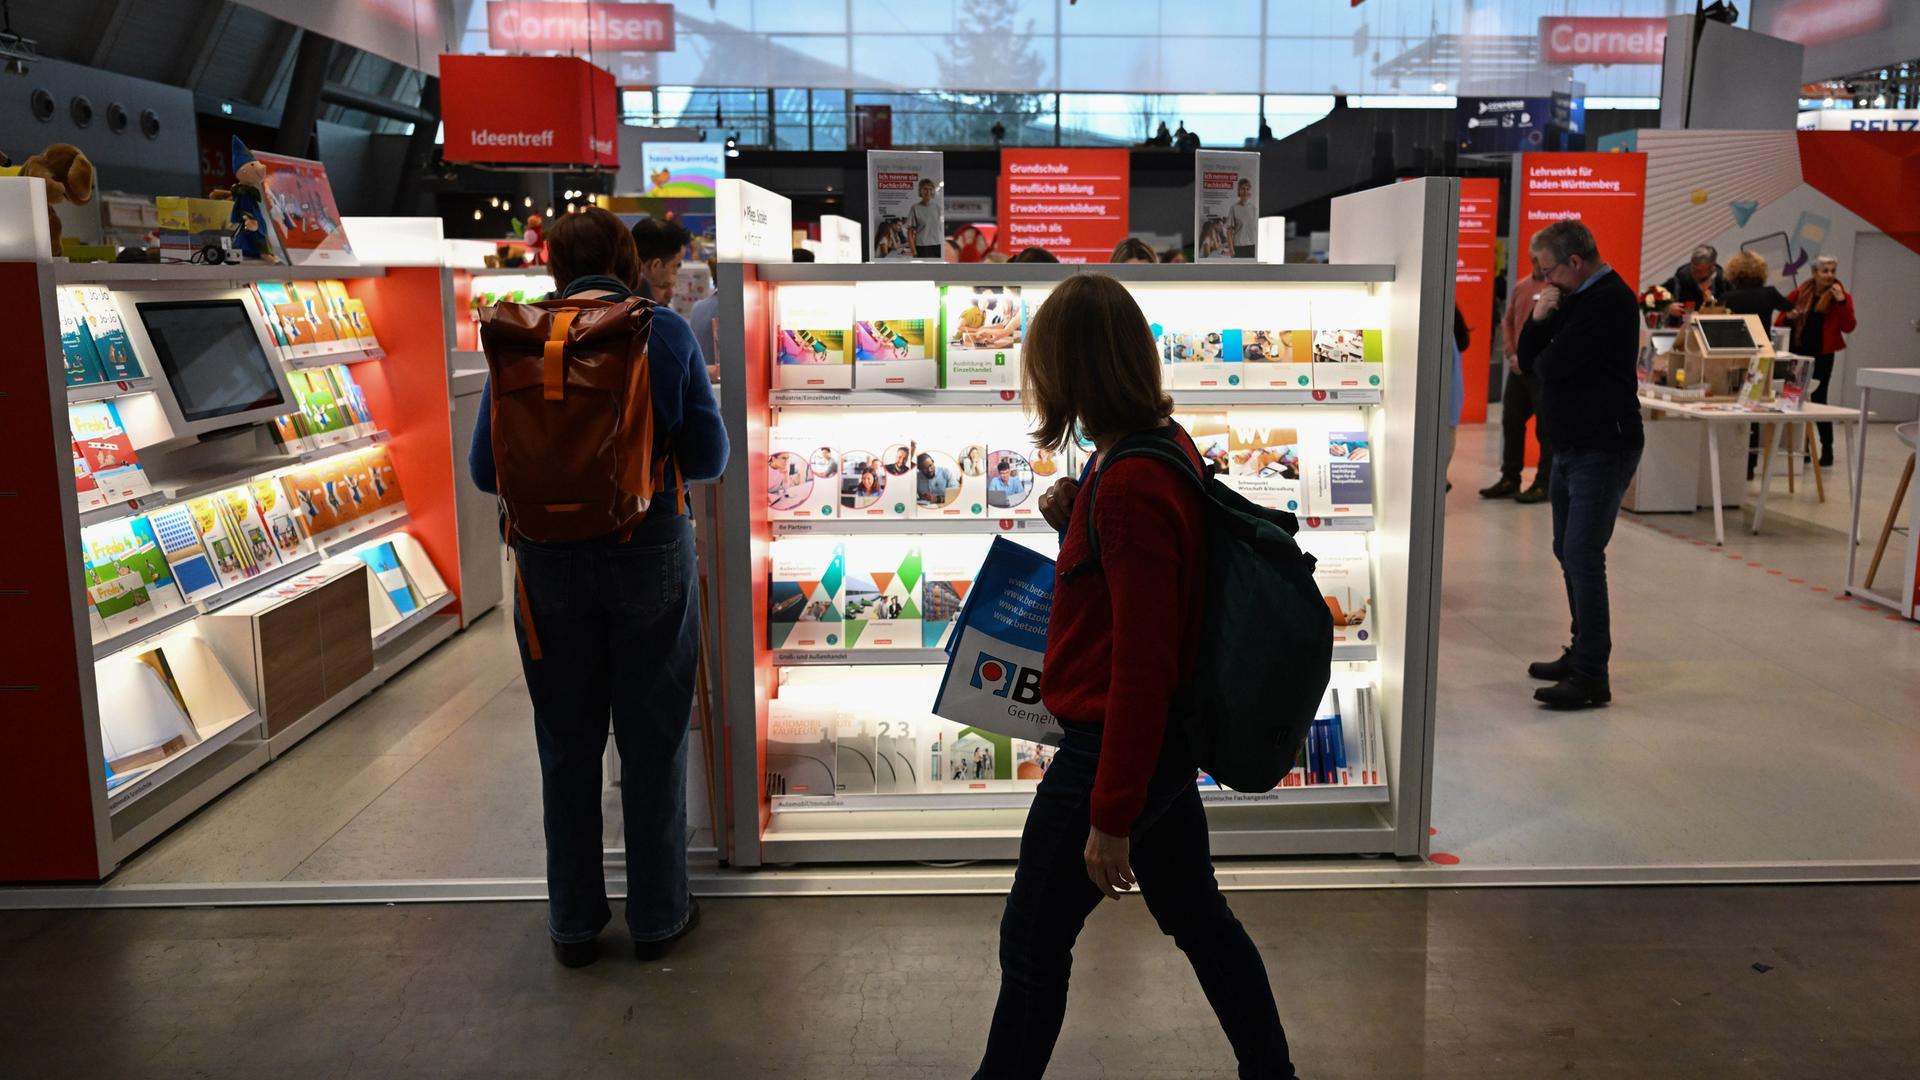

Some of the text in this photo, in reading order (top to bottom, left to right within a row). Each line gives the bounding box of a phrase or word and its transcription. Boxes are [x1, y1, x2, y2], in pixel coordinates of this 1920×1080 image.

[498, 8, 664, 40] Cornelsen
[471, 129, 554, 147] Ideentreff
[1010, 164, 1069, 173] Grundschule
[1530, 167, 1592, 177] Lehrwerke für
[1010, 183, 1094, 195] Berufliche Bildung
[1529, 179, 1620, 191] Baden-Württemberg
[1010, 203, 1106, 215] Erwachsenenbildung
[1528, 210, 1581, 220] Information
[1010, 223, 1062, 232] Deutsch als
[1010, 236, 1071, 246] Zweitsprache
[878, 721, 890, 736] 2
[898, 721, 909, 736] 3
